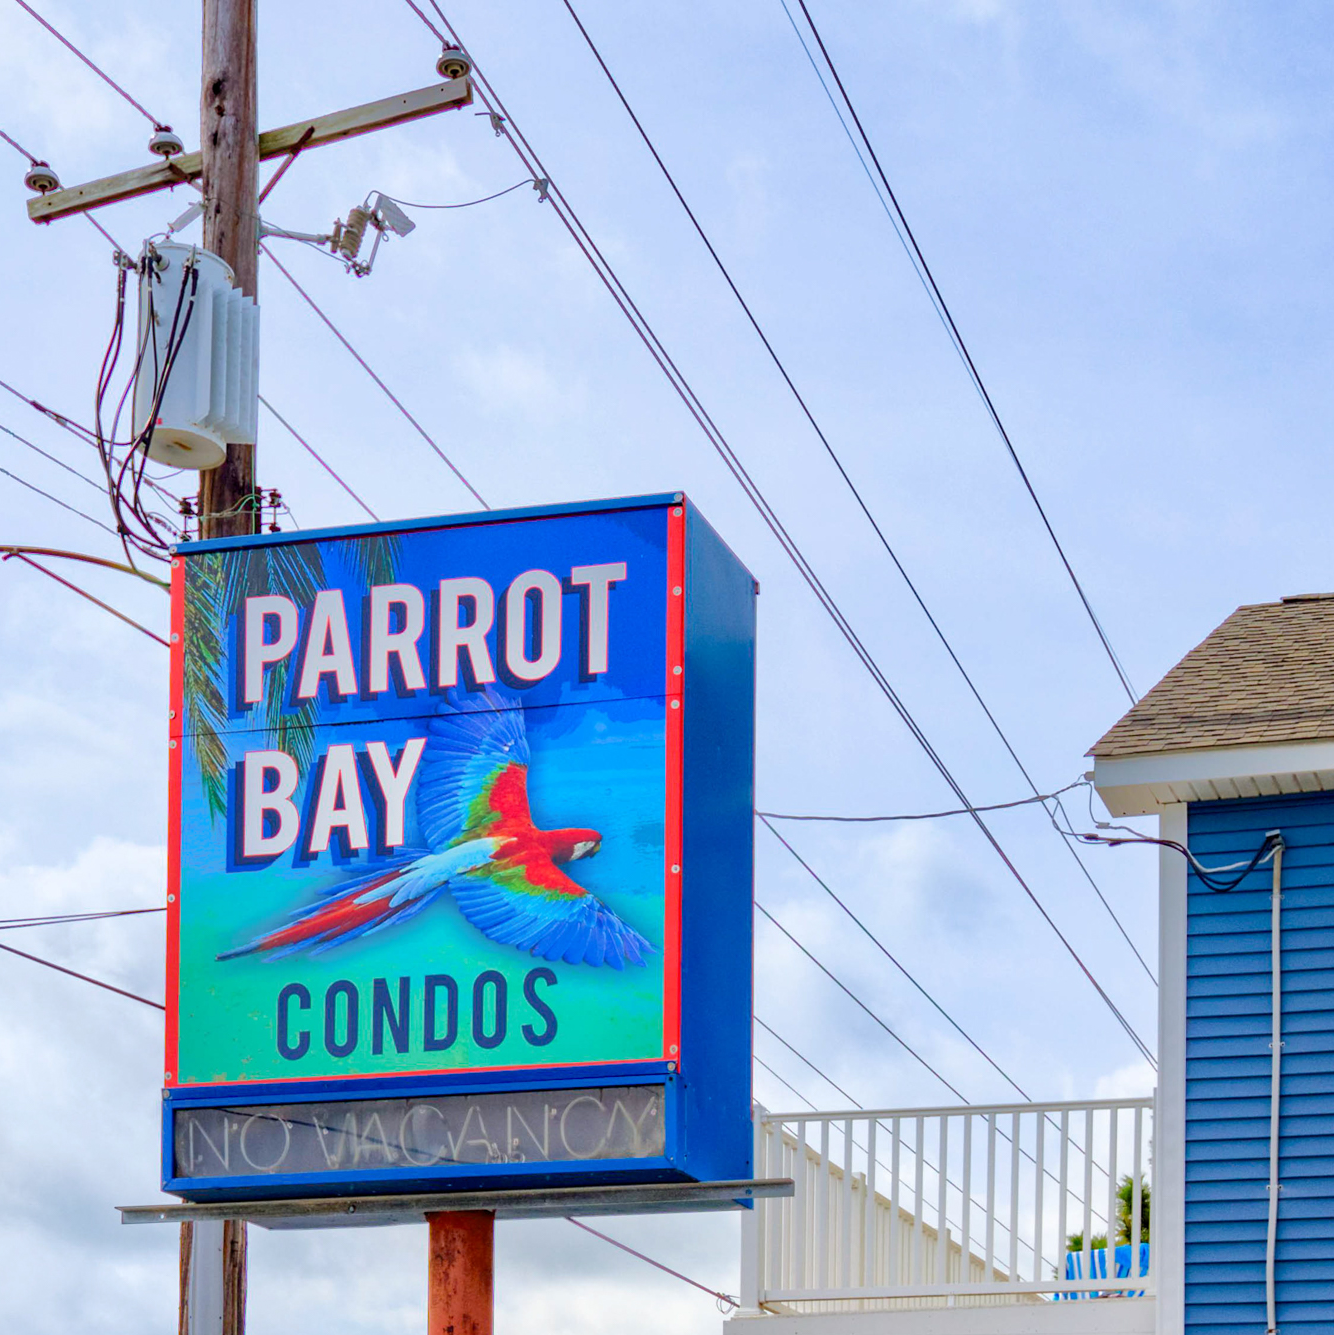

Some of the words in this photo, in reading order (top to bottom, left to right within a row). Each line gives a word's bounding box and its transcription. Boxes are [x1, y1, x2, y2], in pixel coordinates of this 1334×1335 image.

[243, 562, 628, 704] PARROT
[243, 738, 427, 858] BAY
[276, 966, 559, 1061] CONDOS
[189, 1112, 291, 1173] NO
[313, 1095, 660, 1170] VACANCY
